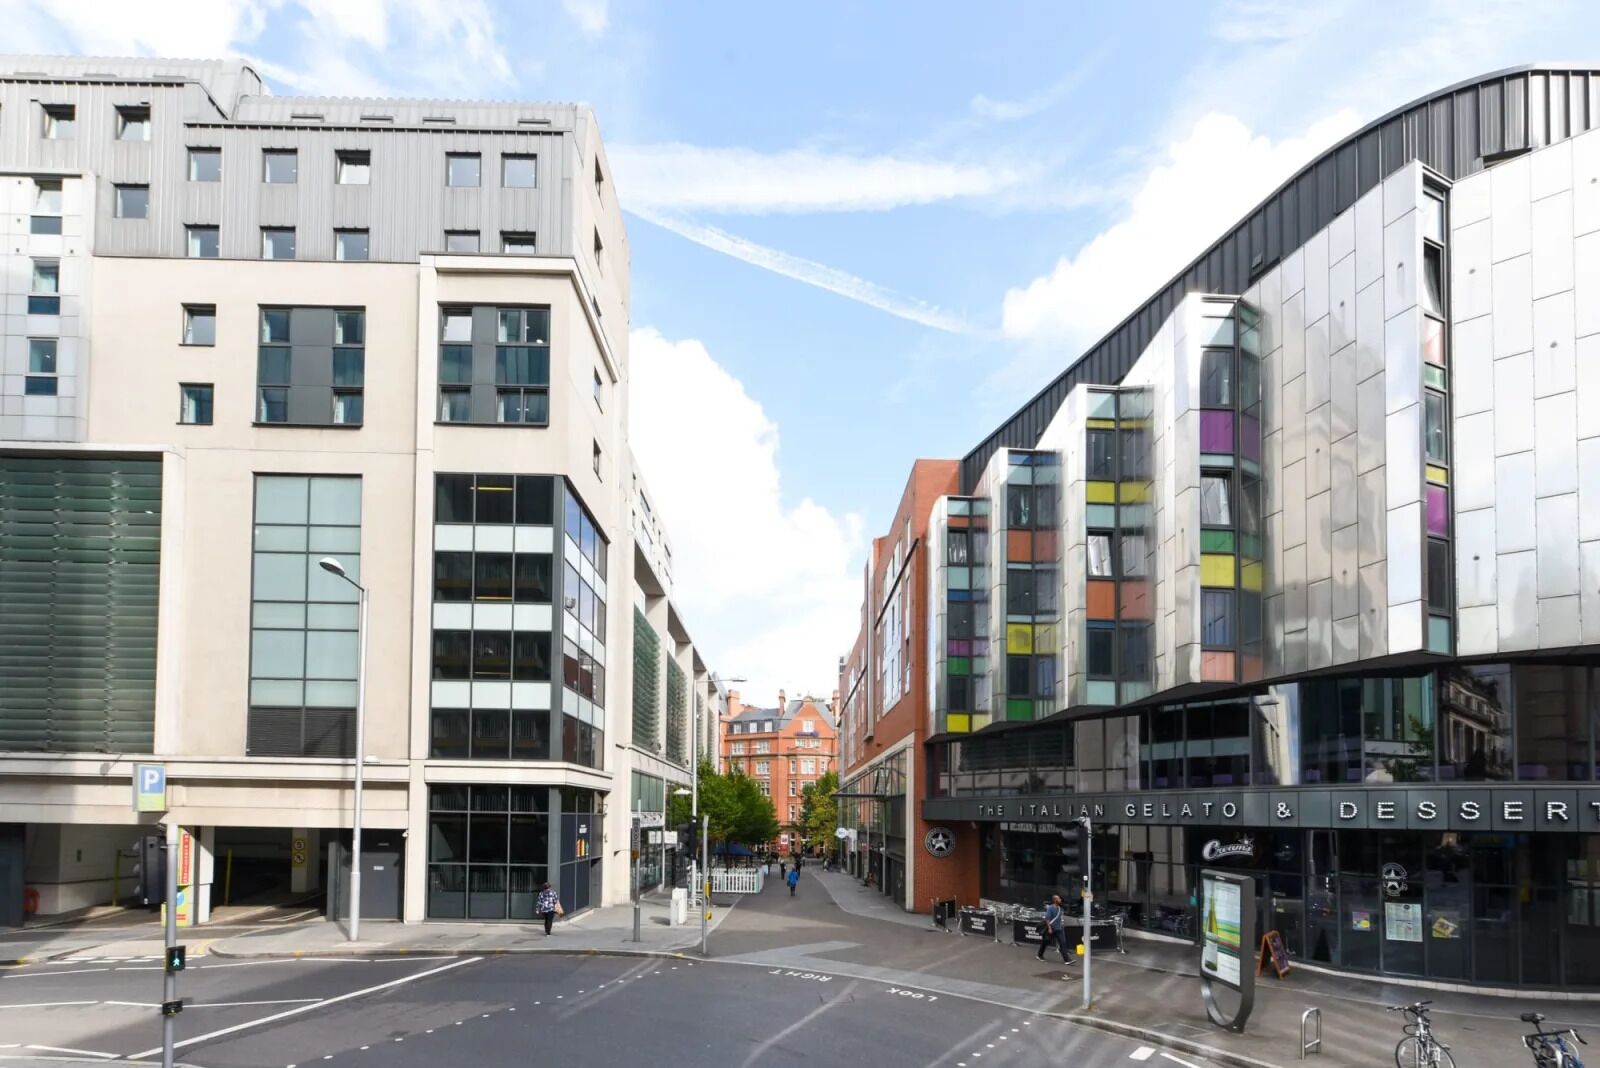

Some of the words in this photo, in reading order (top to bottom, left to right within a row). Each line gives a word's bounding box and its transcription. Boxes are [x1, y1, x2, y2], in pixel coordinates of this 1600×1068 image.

[144, 769, 160, 790] P
[979, 804, 1004, 816] THE
[1019, 804, 1104, 816] ITALIAN
[1125, 802, 1237, 818] GELATO
[1276, 802, 1292, 818] &
[768, 969, 833, 982] RIGHT
[885, 987, 938, 1002] LOOK
